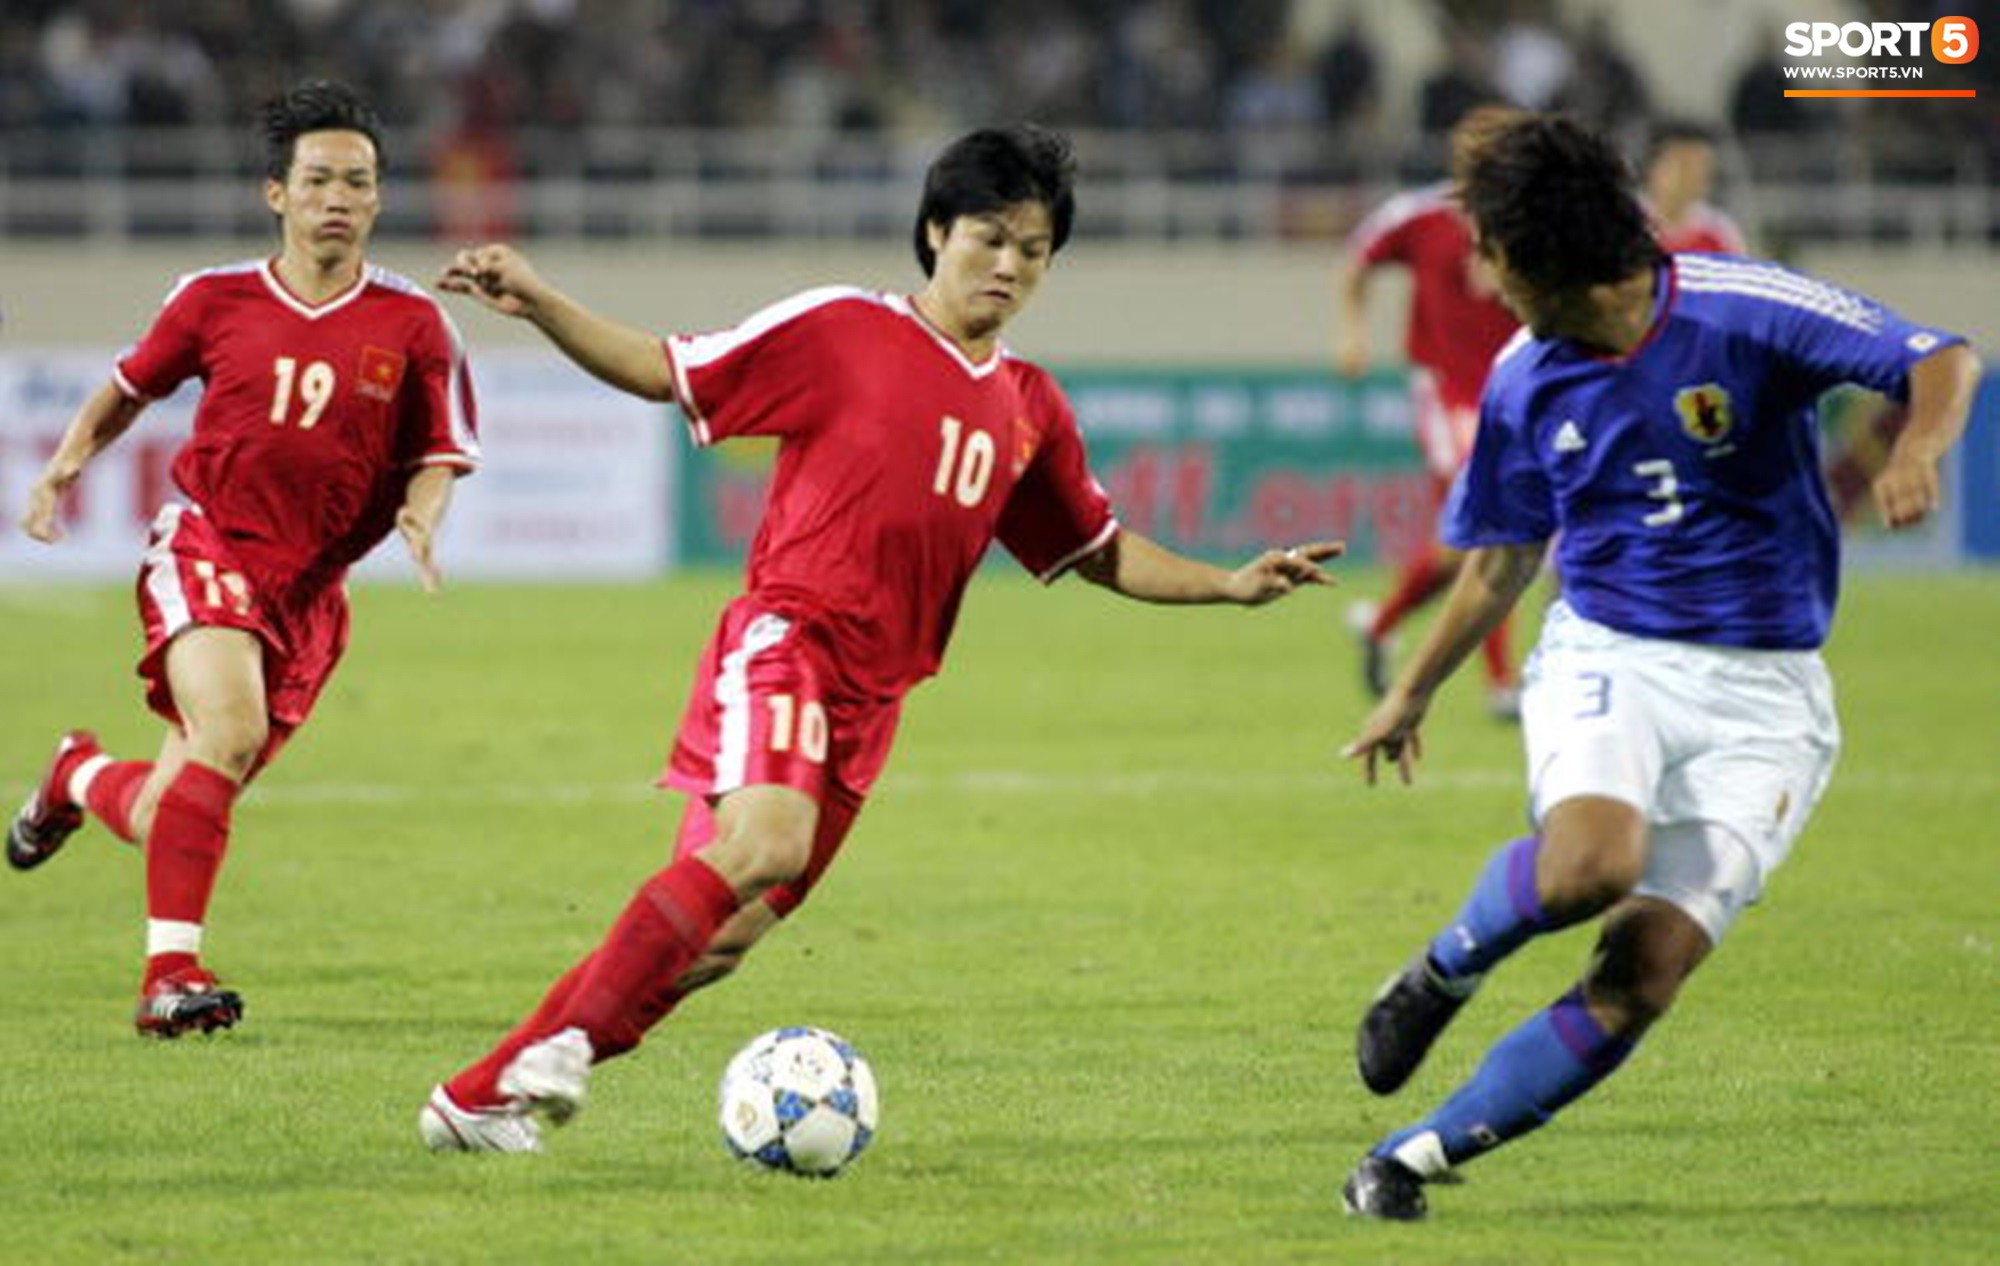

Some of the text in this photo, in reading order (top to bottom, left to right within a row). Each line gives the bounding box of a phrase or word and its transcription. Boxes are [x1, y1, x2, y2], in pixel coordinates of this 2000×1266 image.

[269, 356, 336, 430] 19
[933, 415, 995, 507] 10
[1633, 459, 1684, 527] 3
[766, 694, 828, 764] 10
[1574, 671, 1612, 719] 3
